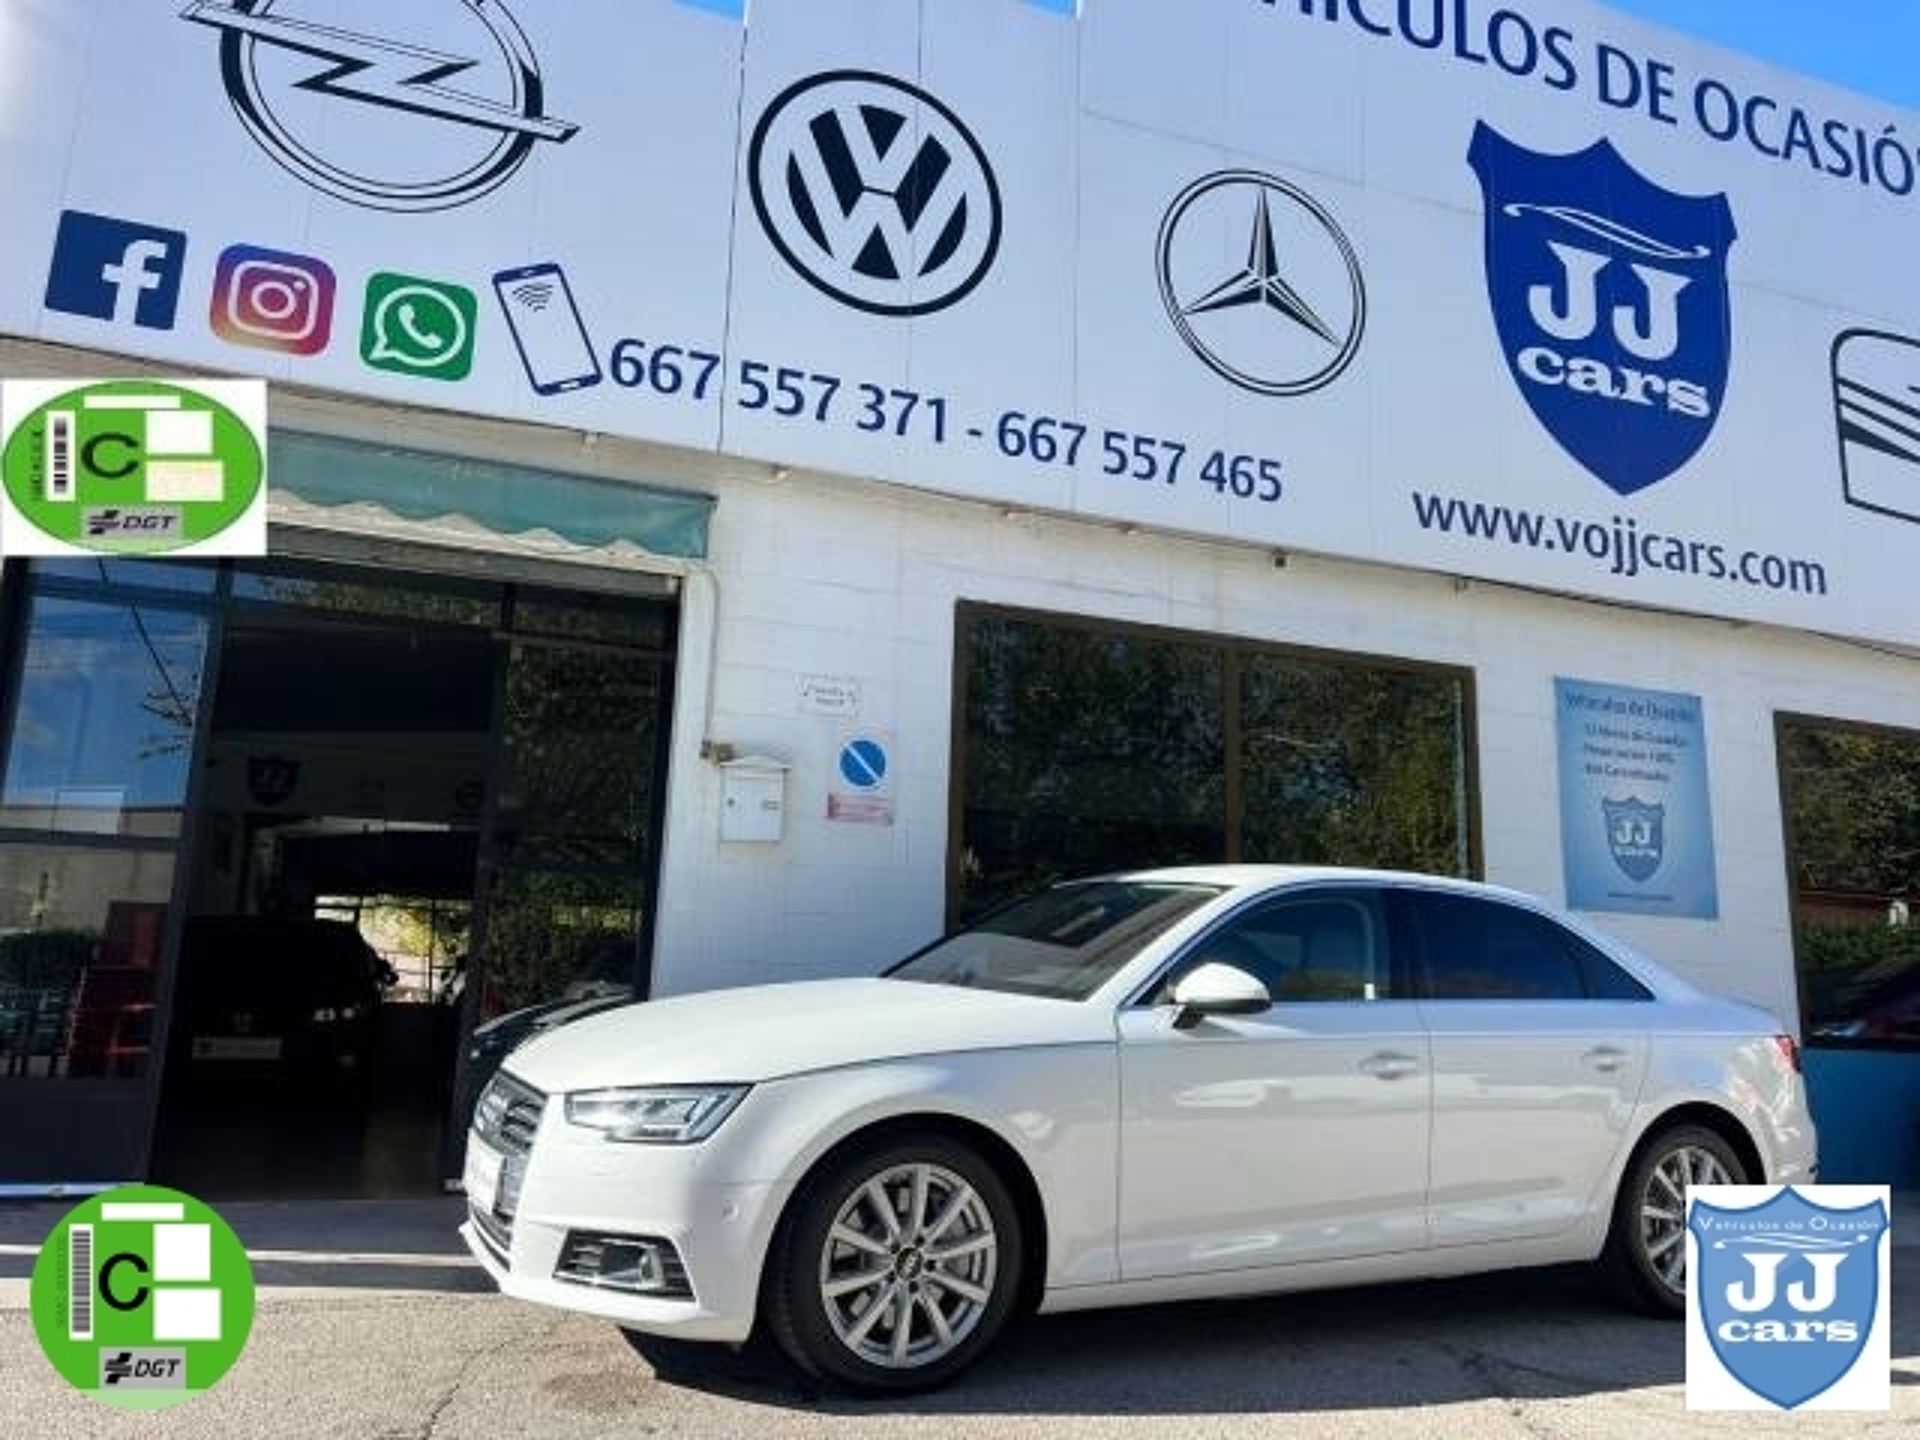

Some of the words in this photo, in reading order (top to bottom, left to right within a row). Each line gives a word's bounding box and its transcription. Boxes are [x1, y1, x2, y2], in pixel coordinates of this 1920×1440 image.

[1262, 0, 1578, 90] CULOS
[1596, 44, 1678, 125] DE
[1693, 79, 1920, 196] OCASIÓ
[1528, 240, 1692, 361] JJ
[610, 338, 721, 400] 667
[737, 360, 841, 422] 557
[856, 383, 946, 444] 371
[967, 428, 983, 438] -
[997, 411, 1087, 467] 667
[1103, 430, 1187, 485] 557
[1199, 450, 1282, 503] 465
[1516, 347, 1711, 418] cars
[1411, 491, 1827, 596] www.vojjcars.com
